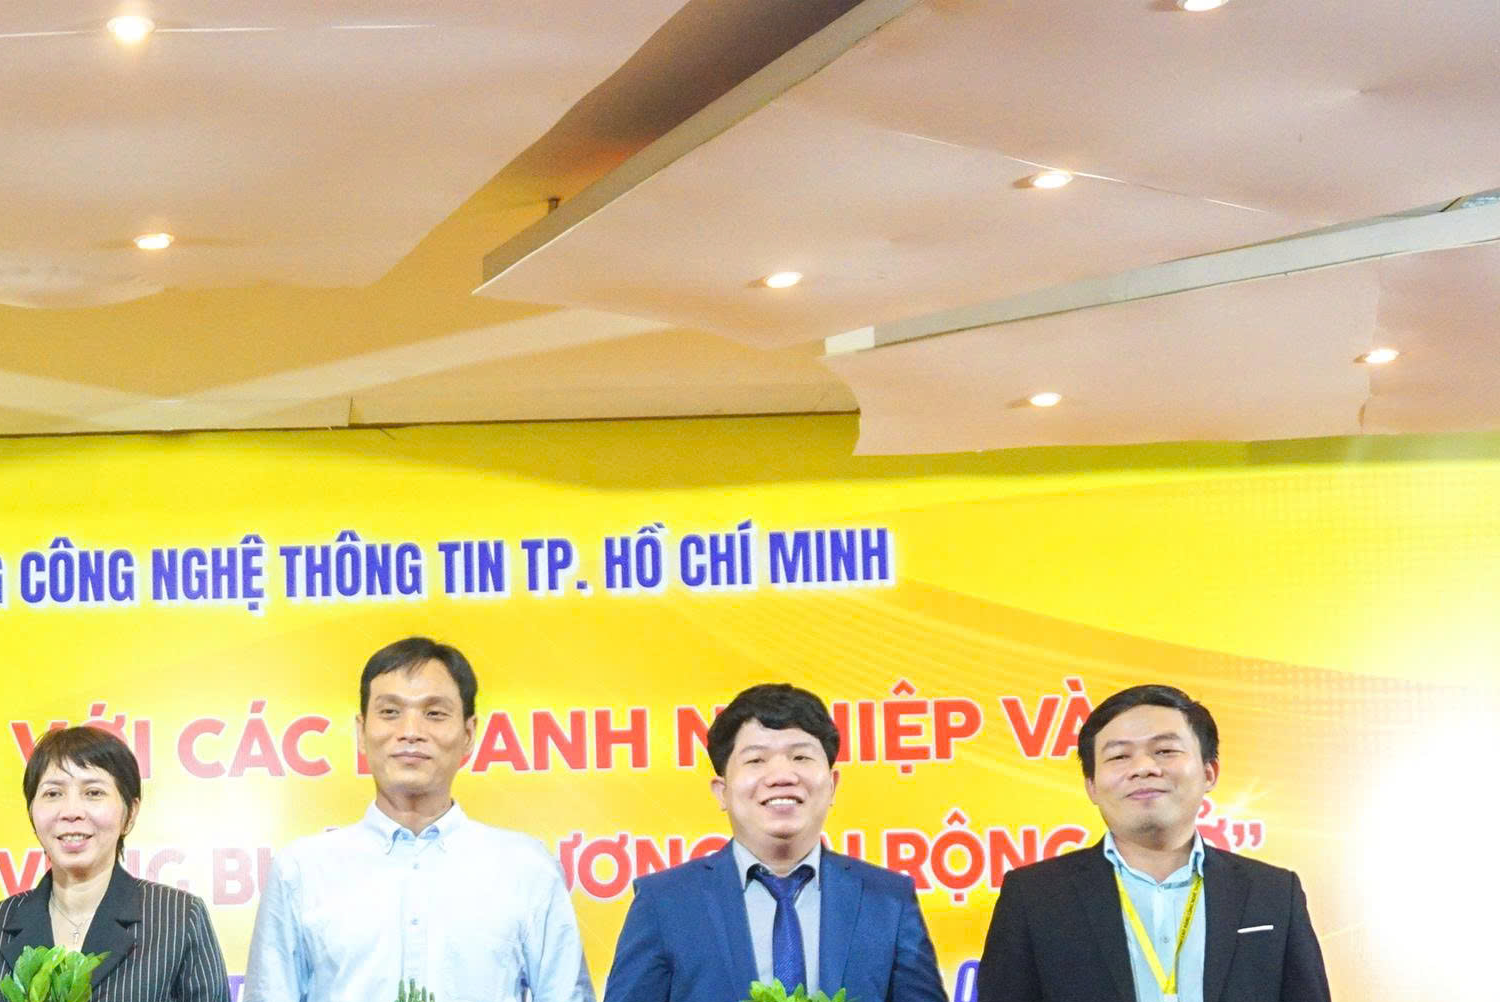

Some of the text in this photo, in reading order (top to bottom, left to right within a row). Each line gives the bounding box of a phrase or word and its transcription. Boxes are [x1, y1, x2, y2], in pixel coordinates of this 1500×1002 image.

[21, 537, 134, 604] CÔNG
[152, 535, 265, 611] NGHỆ
[280, 530, 422, 598] THÔNG
[439, 541, 504, 594] TIN
[521, 539, 588, 592] TP.
[605, 522, 664, 590] HỒ
[680, 520, 752, 588] CHÍ
[769, 527, 890, 585] MINH
[177, 700, 331, 778] CÁC
